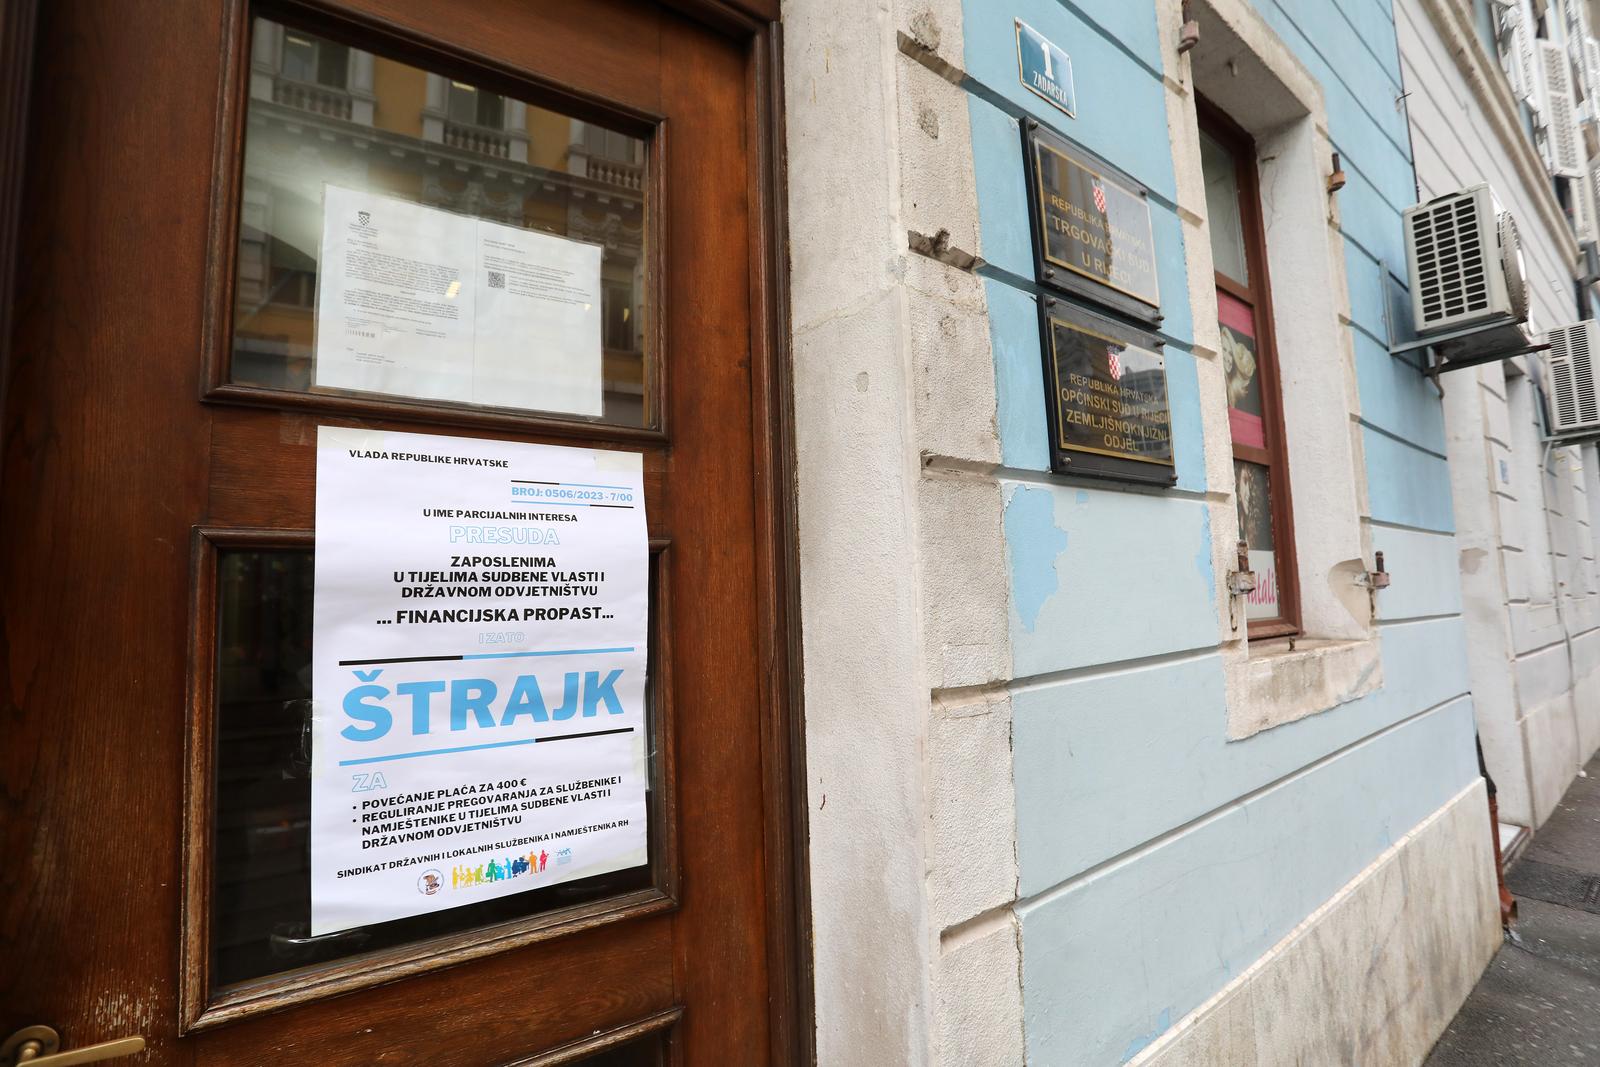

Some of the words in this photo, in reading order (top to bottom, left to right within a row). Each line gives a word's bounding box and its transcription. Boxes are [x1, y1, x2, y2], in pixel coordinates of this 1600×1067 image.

[1041, 42, 1054, 81] 1
[1032, 70, 1068, 107] ZADARSKA
[1051, 194, 1105, 231] REPUBLIKA
[1081, 251, 1091, 268] U
[1061, 387, 1110, 411] OPĆINSKI
[1112, 400, 1131, 415] SUD
[1070, 373, 1119, 395] REPUBLIKA
[1120, 387, 1159, 406] HRVATSKA
[1104, 434, 1140, 452] ODJEL
[349, 449, 389, 460] VLADA
[391, 452, 452, 464] REPUBLIKE
[453, 456, 509, 468] HRVATSKE
[511, 486, 543, 497] BROJ:
[545, 489, 604, 500] 0506/2023
[610, 492, 633, 502] 7/00
[423, 508, 431, 517] U
[433, 509, 454, 518] IME
[456, 509, 527, 521] PARCIJALNIH
[528, 512, 578, 522] INTERESA
[449, 525, 560, 546] PRESUDA
[450, 556, 556, 568] ZAPOSLENIMA
[393, 571, 404, 583] U
[408, 571, 478, 583] TIJELIMA
[481, 571, 548, 582] SUDBENE
[551, 571, 598, 582] VLASTI
[600, 571, 605, 582] I
[401, 584, 492, 598] DRŽAVNOM
[494, 583, 598, 597] ODVJETNIŠTVU
[396, 608, 520, 624] FINANCIJSKA
[523, 606, 614, 621] PROPAST...
[340, 669, 625, 742] ŠTRAJK
[352, 771, 388, 793] ZA
[362, 791, 435, 810] POVEĆANJE
[437, 784, 476, 799] PLAĆA
[479, 782, 495, 793] ZA
[496, 779, 519, 790] 400
[520, 778, 527, 787] €
[362, 802, 445, 823] REGULIRANJE
[447, 788, 538, 810] PREGOVARANJA
[539, 786, 554, 796] ZA
[555, 776, 617, 794] SLUŽBENIKE
[618, 775, 622, 784] I
[362, 813, 456, 836] NAMJEŠTENIKE
[458, 811, 466, 821] U
[468, 803, 519, 820] TIJELIMA
[520, 795, 569, 811] SUDBENE
[571, 789, 606, 803] VLASTI
[607, 788, 611, 797] I
[362, 829, 435, 850] DRŽAVNOM
[436, 815, 522, 837] ODVJETNIŠTVU
[337, 862, 387, 879] SINDIKAT
[389, 852, 440, 870] DRŽAVNIH
[446, 843, 494, 859] LOKALNIH
[495, 833, 550, 850] SLUŽBENIKA
[555, 821, 617, 839] NAMJEŠTENIKA
[618, 819, 629, 827] RH
